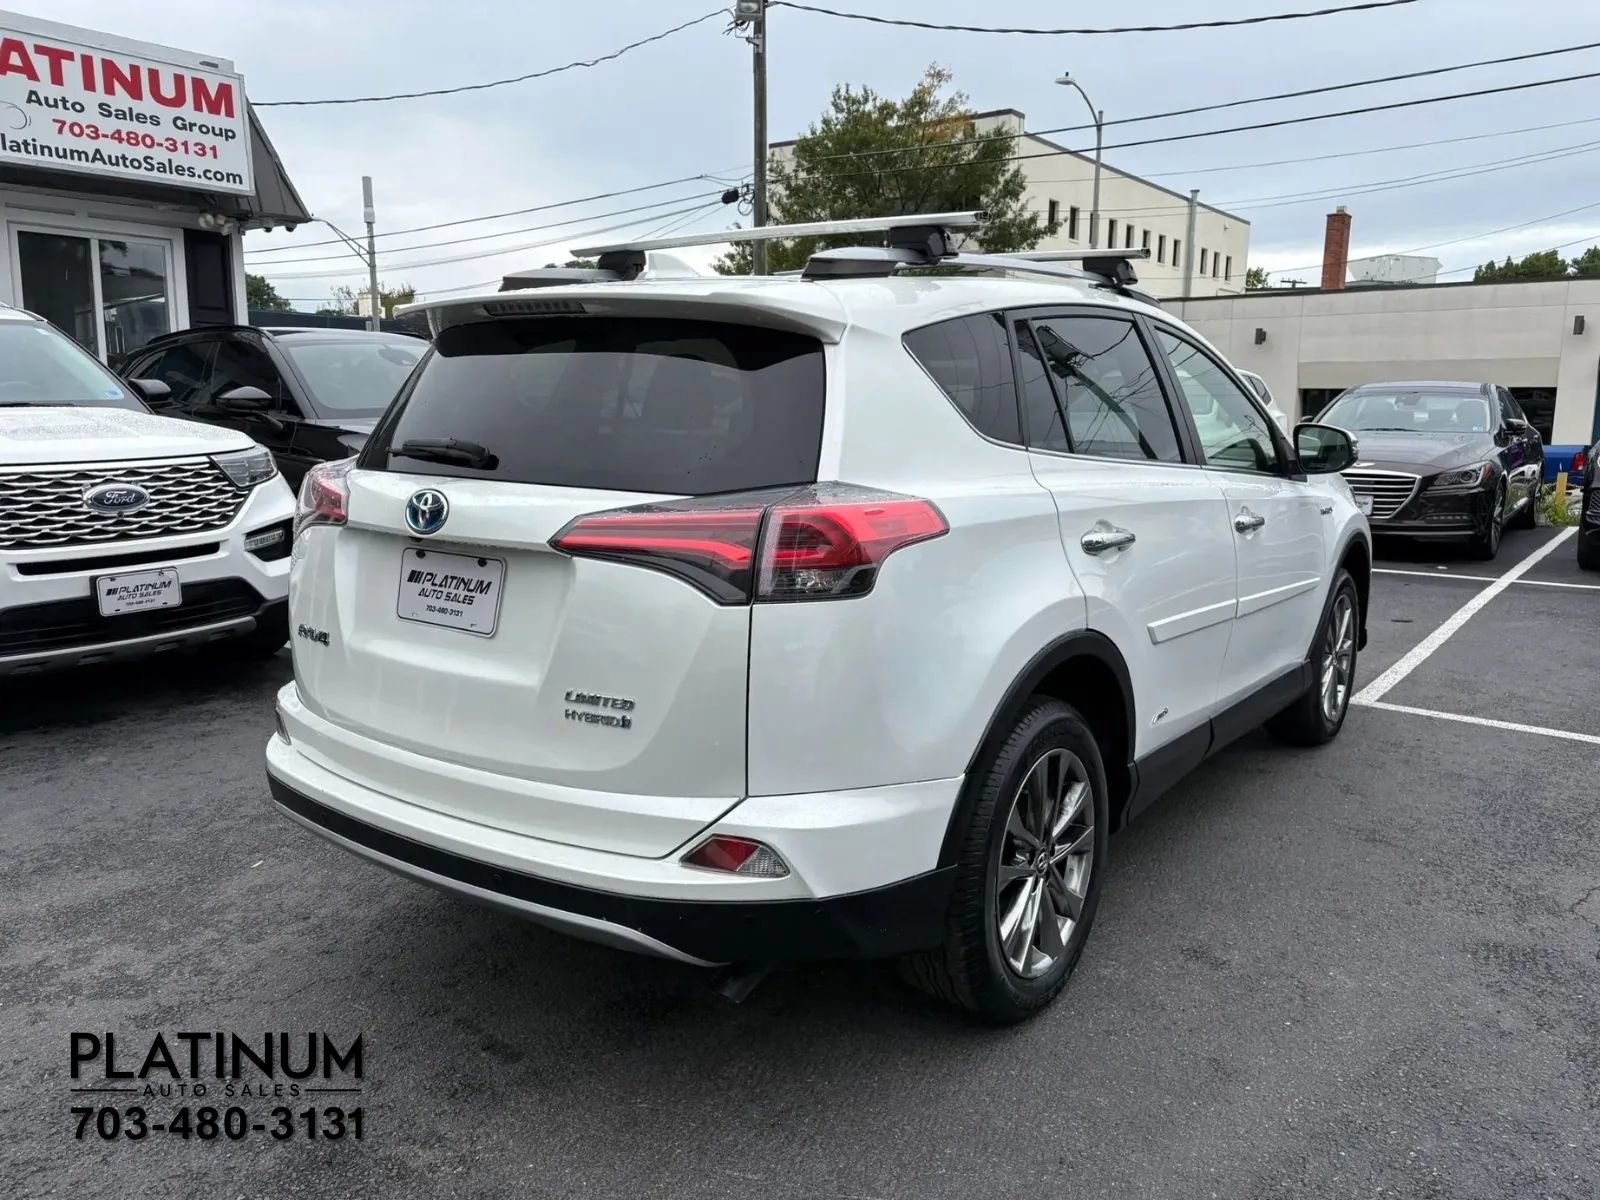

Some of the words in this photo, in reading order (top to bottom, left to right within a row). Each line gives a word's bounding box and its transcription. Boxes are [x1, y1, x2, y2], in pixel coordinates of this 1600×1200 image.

[26, 90, 86, 114] Auto
[98, 102, 161, 127] Sales
[172, 116, 237, 141] Group
[52, 119, 218, 159] 703-480-3131
[0, 133, 244, 185] latinumAutoSales.com
[103, 490, 136, 504] Ford
[119, 580, 172, 594] PLATINUM
[422, 572, 492, 595] PLATINUM
[418, 587, 444, 600] AUTO
[444, 592, 475, 605] SALES
